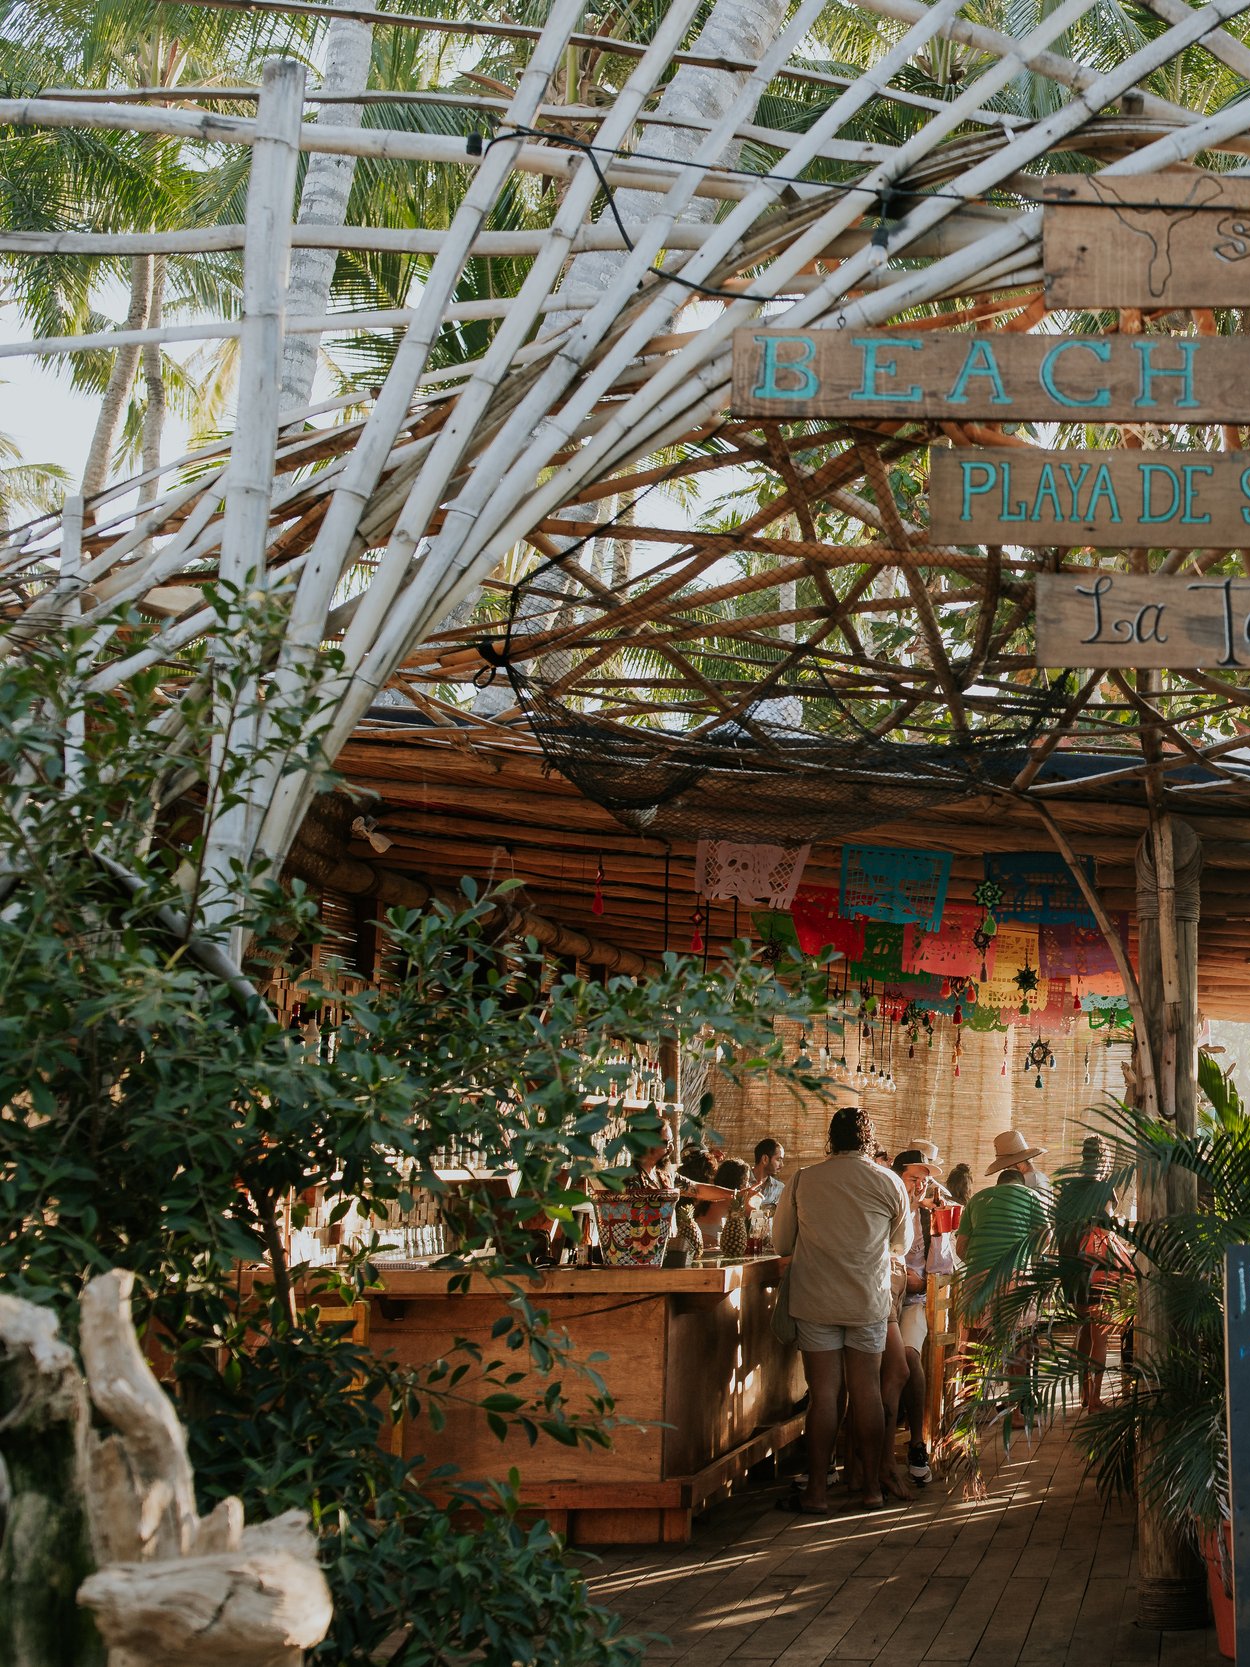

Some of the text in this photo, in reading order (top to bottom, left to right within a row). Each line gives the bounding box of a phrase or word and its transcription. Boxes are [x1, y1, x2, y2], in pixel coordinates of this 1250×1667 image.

[752, 334, 1201, 408] BEACH
[960, 460, 1121, 524] PLAYA
[1138, 463, 1214, 525] DE
[1075, 575, 1168, 646] La
